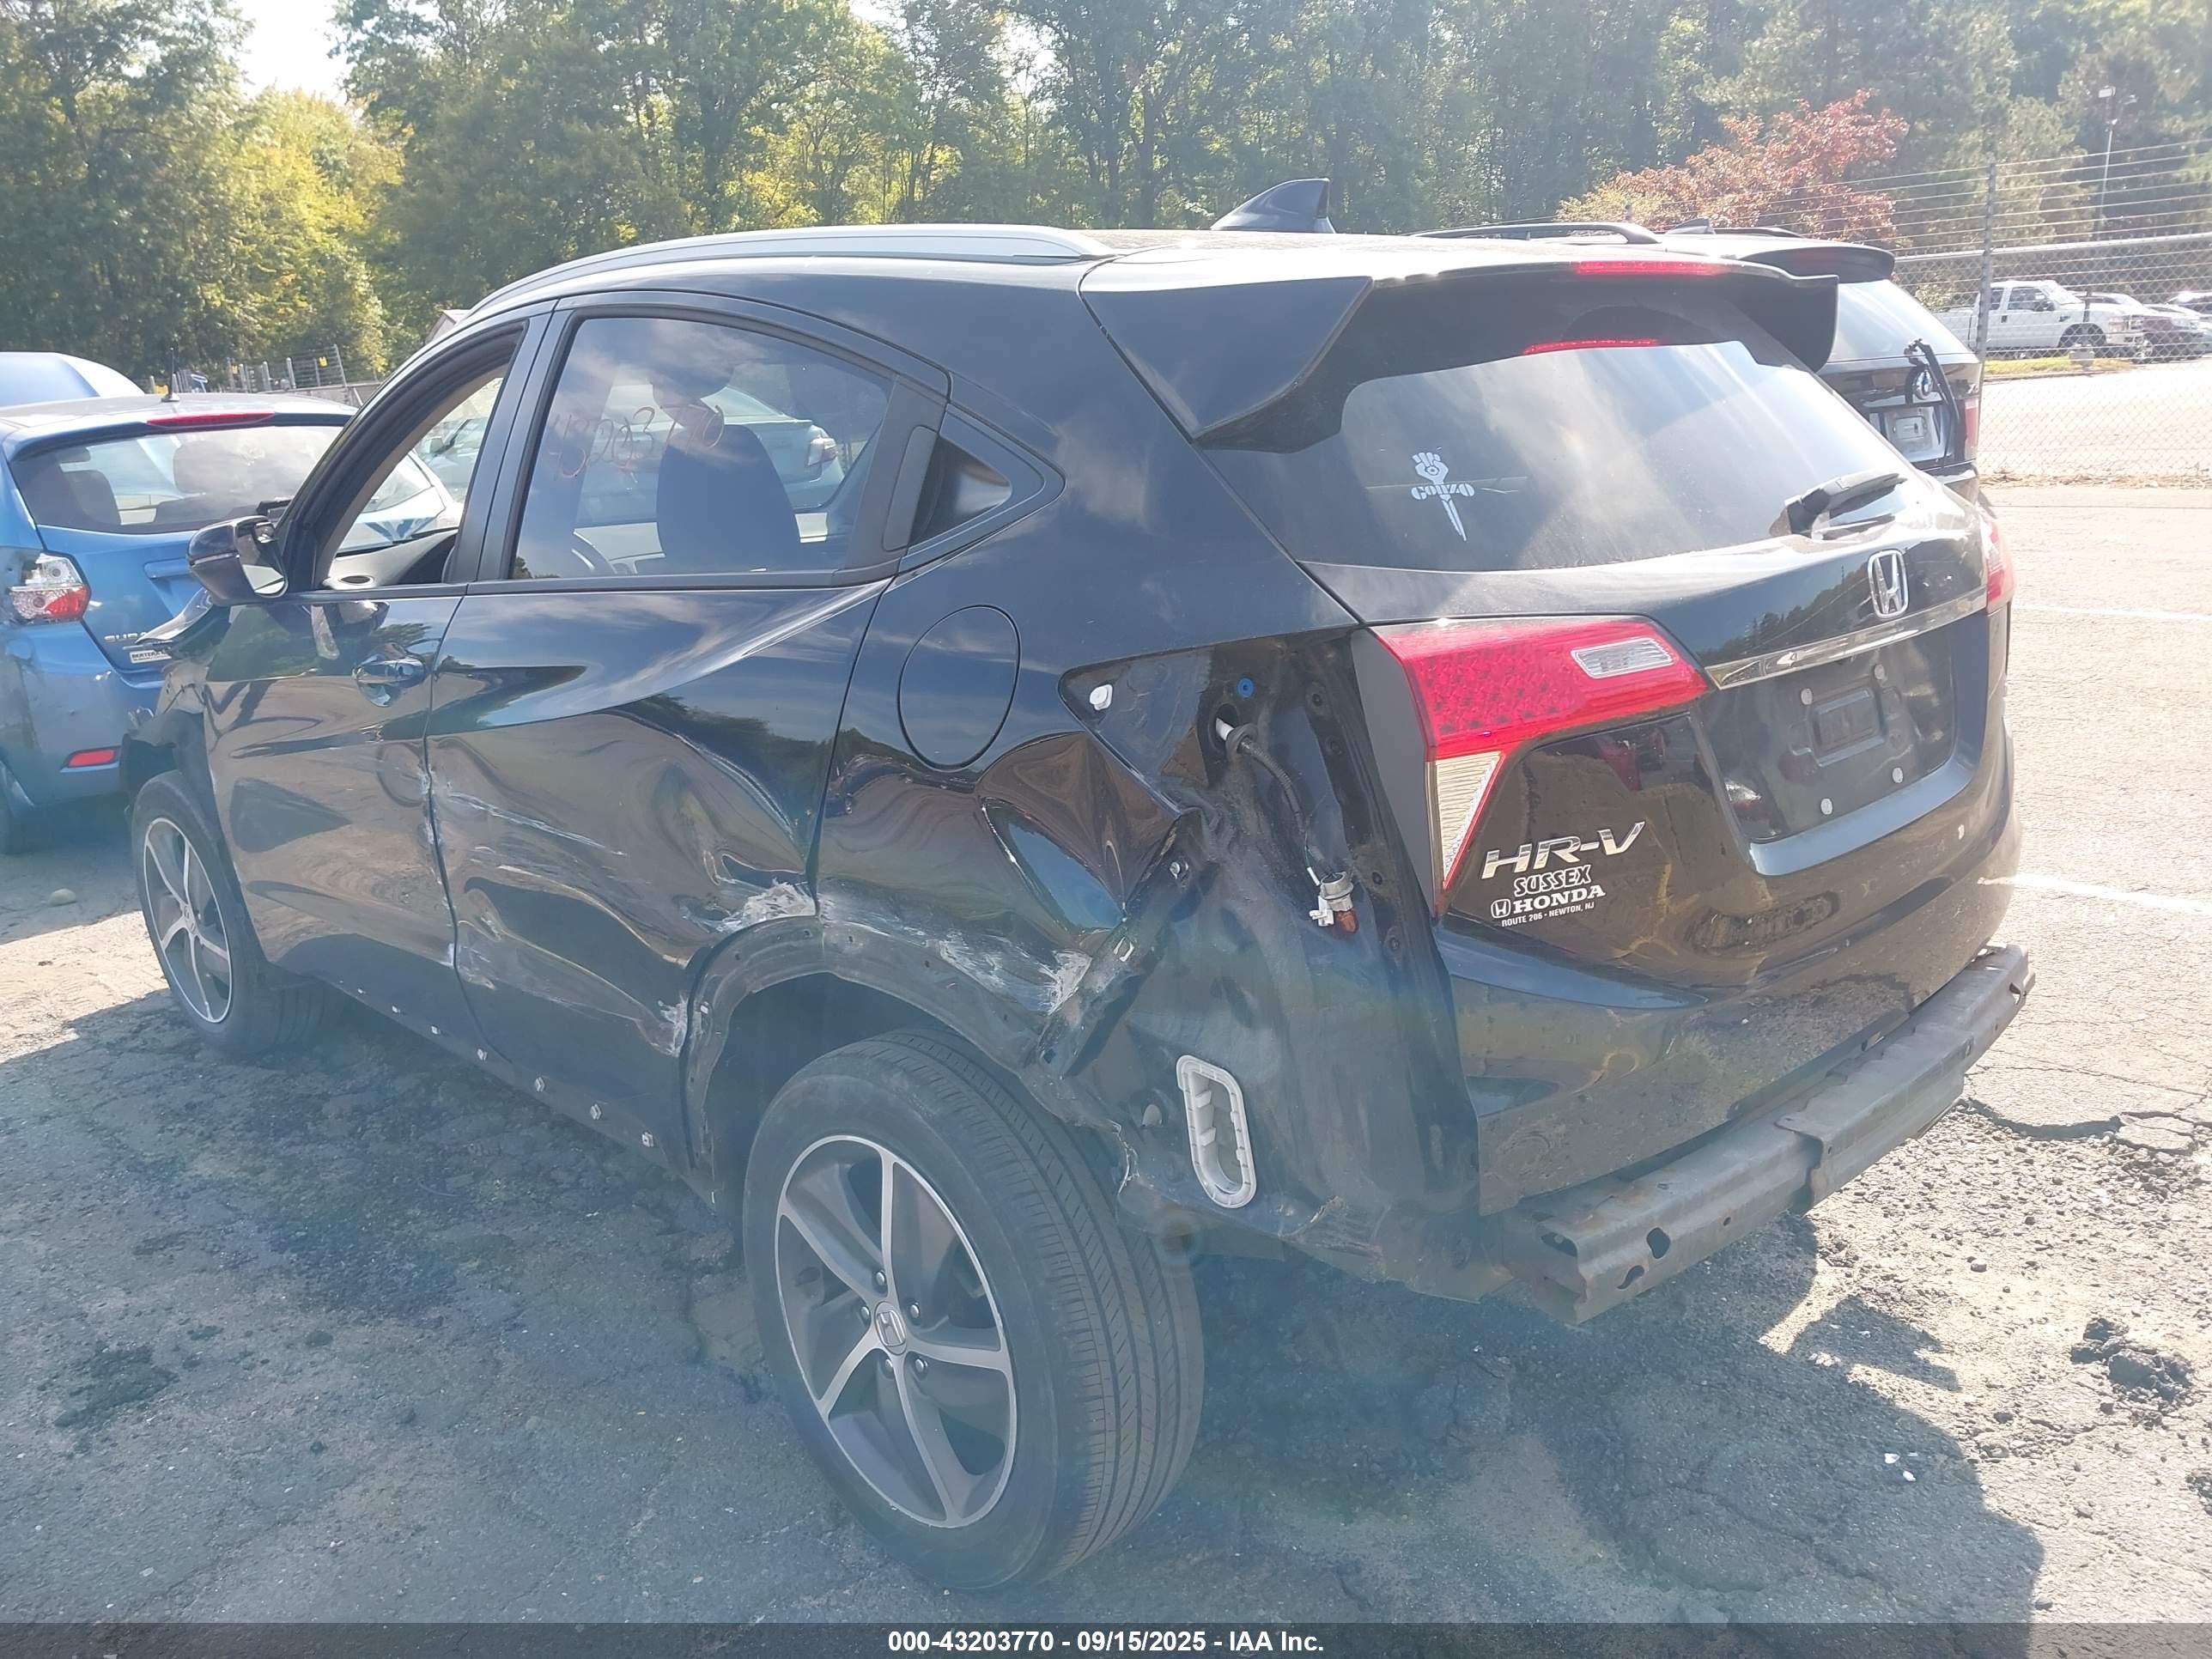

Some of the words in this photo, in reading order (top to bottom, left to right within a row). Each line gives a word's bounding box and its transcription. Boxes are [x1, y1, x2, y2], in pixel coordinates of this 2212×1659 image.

[1481, 821, 1646, 879] HR-V
[1513, 865, 1592, 897] SUSSEX
[1501, 915, 1527, 927] ROUTE
[1528, 912, 1543, 921] 206
[1548, 904, 1583, 917] NEWTON,
[1585, 902, 1595, 910] NJ
[1513, 884, 1607, 914] HONDA
